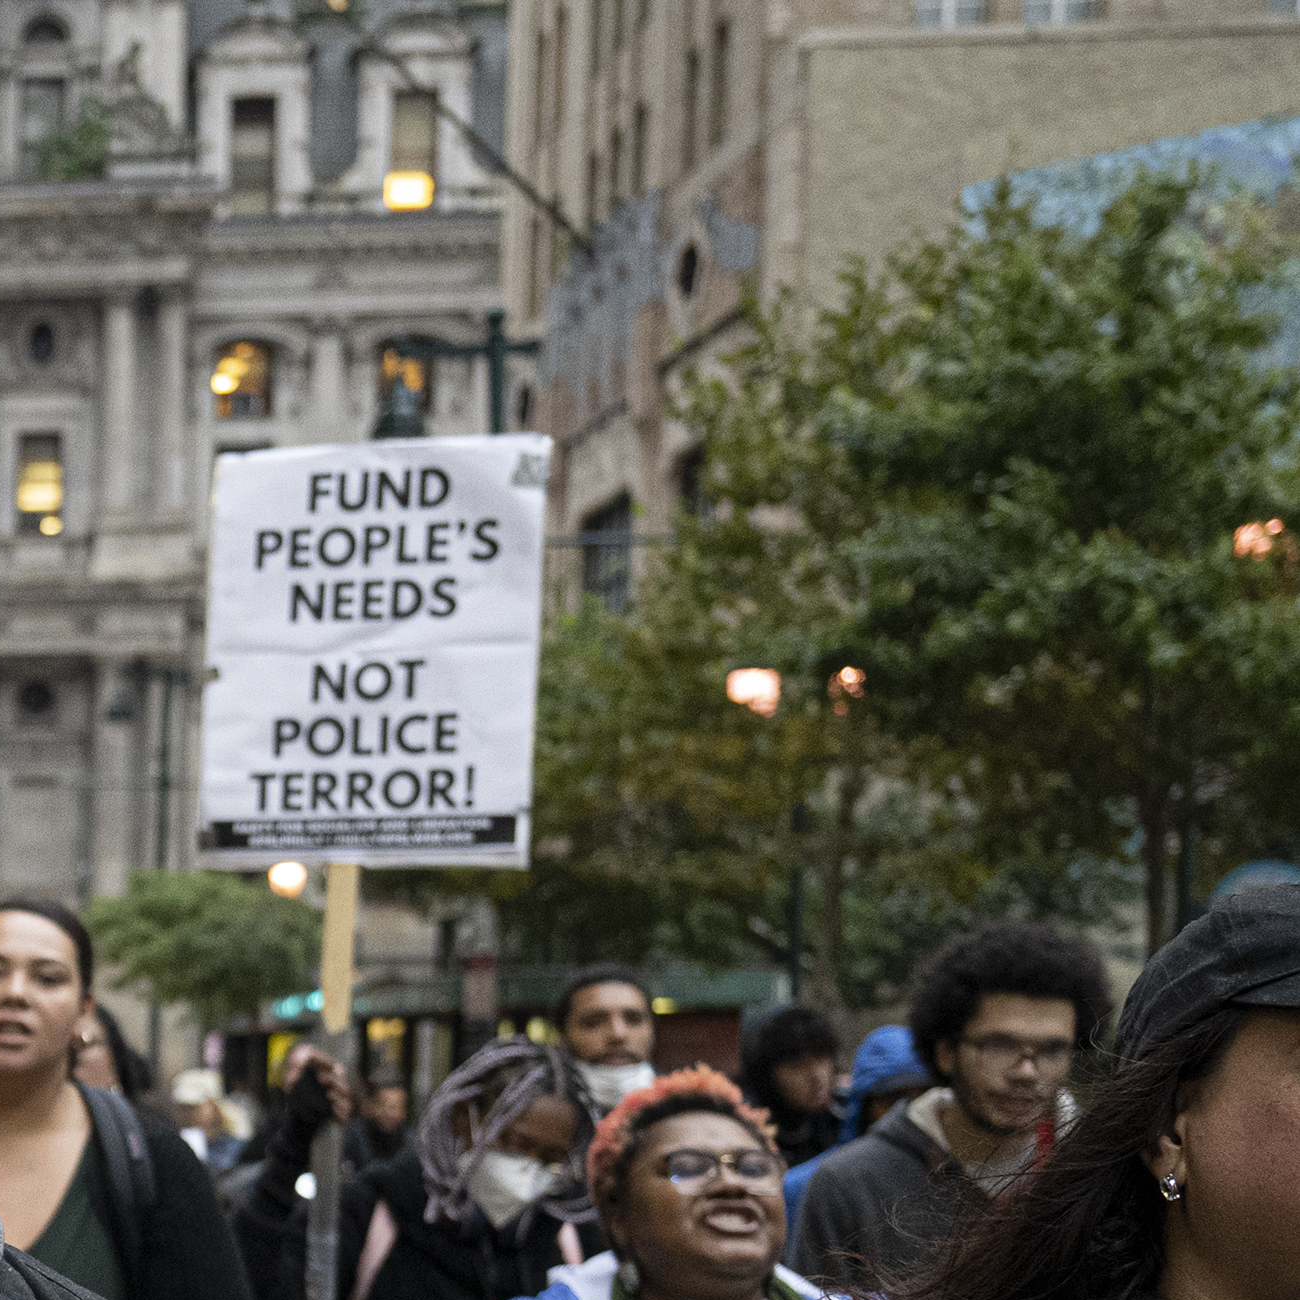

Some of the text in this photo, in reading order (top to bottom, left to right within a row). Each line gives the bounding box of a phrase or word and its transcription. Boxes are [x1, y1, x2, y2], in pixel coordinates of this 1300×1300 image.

[307, 467, 451, 514] FUND
[253, 518, 500, 571] PEOPLE'S
[289, 577, 458, 624] NEEDS
[310, 659, 425, 703] NOT
[272, 712, 459, 758] POLICE
[250, 766, 475, 812] TERROR!
